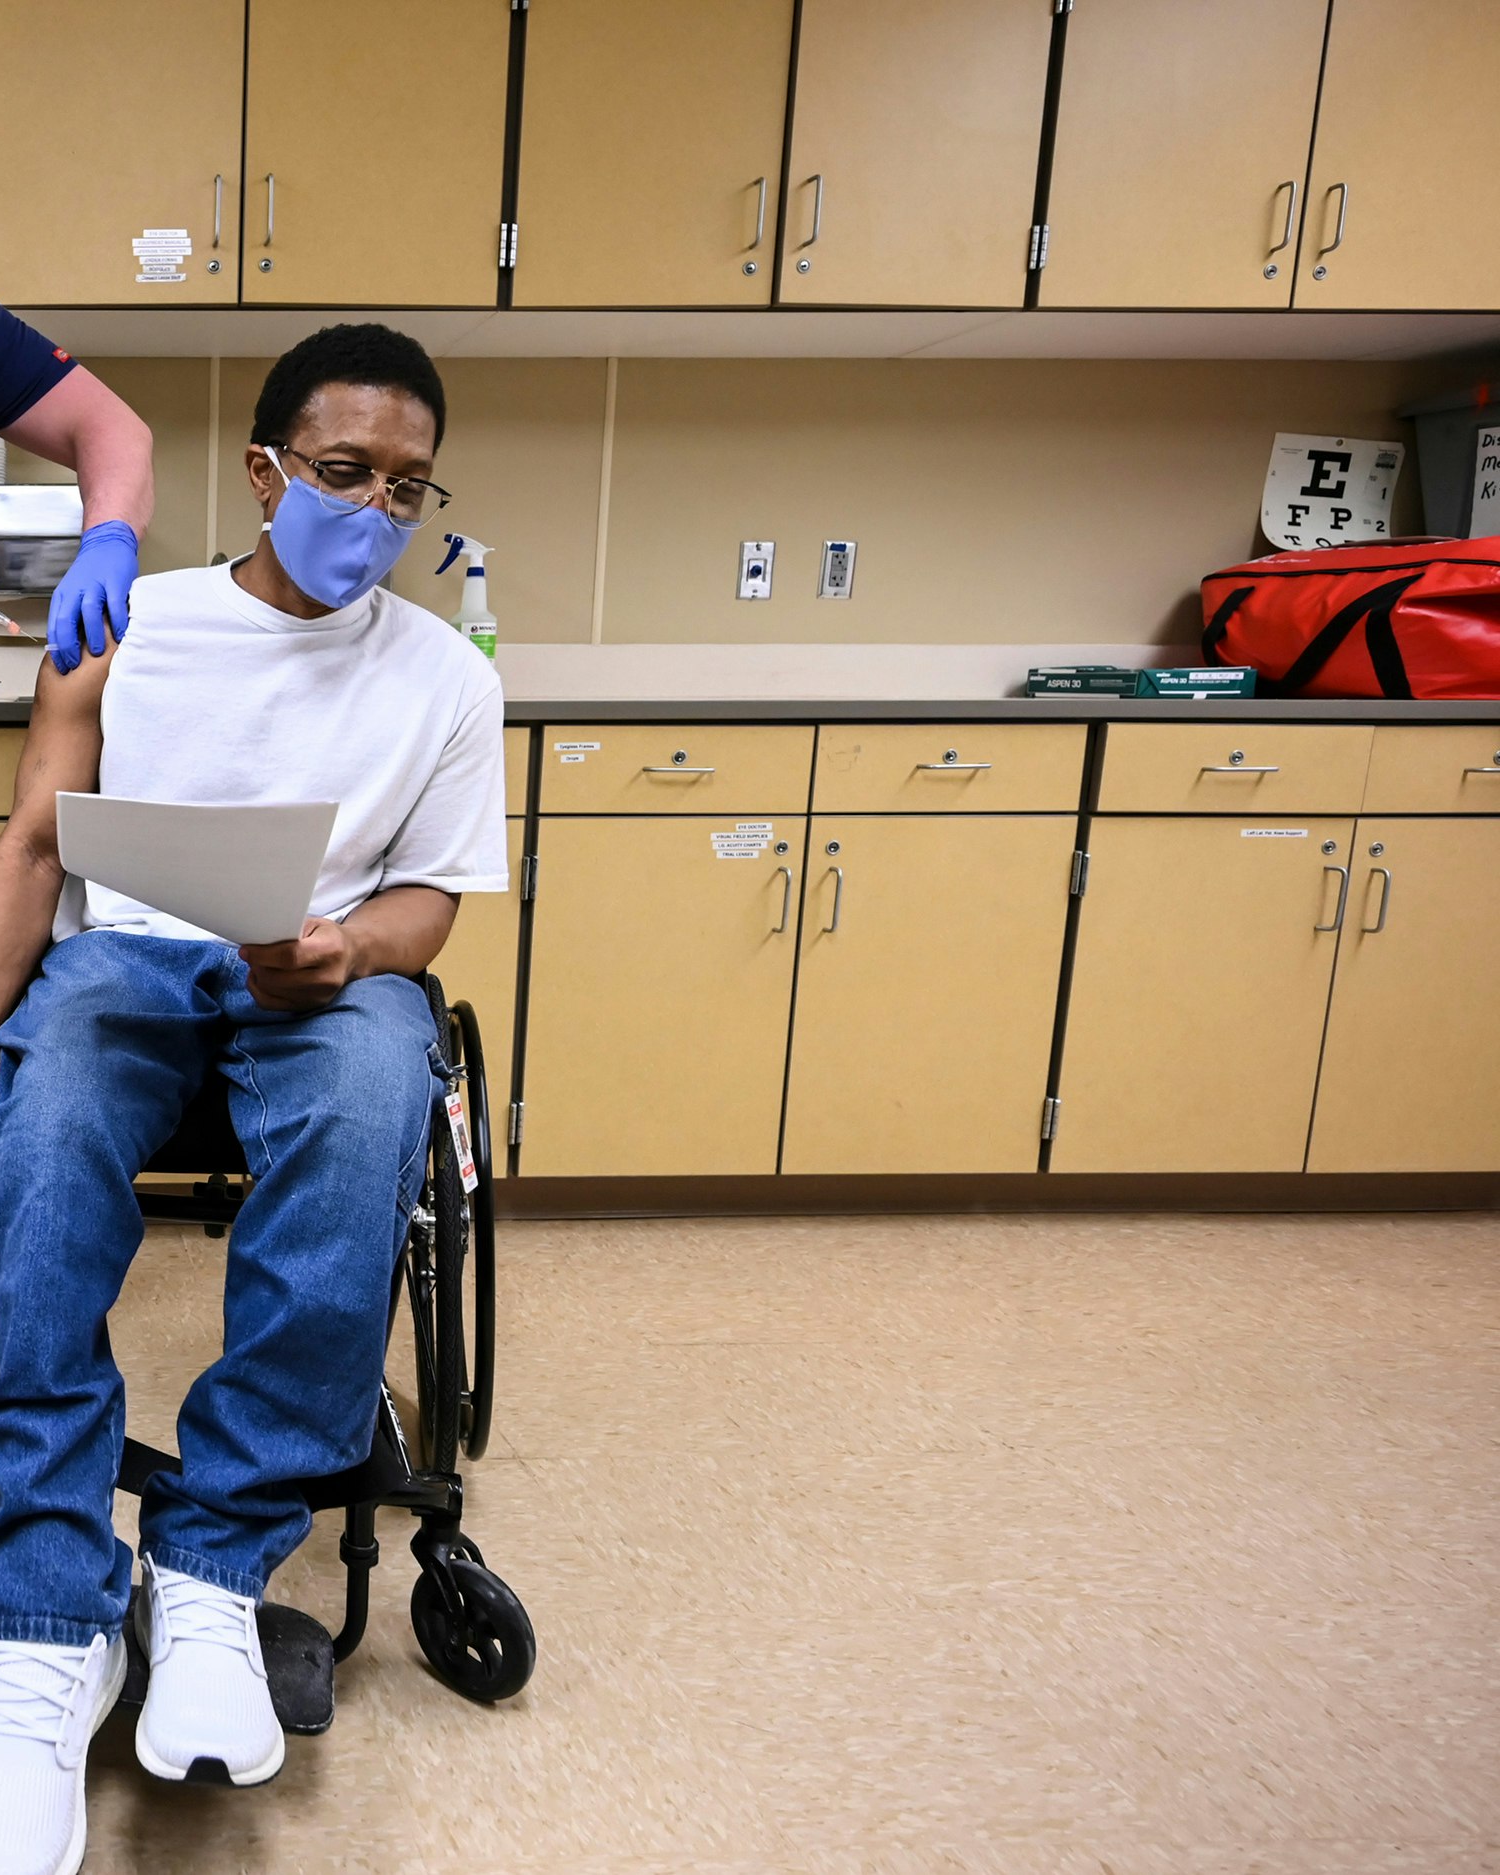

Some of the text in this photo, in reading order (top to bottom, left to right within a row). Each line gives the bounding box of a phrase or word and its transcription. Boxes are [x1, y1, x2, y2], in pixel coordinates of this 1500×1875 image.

[1300, 450, 1352, 499] E
[1381, 487, 1387, 500] 1
[1288, 504, 1352, 530] F P
[1376, 521, 1386, 532] 2
[1284, 535, 1302, 546] T
[1047, 679, 1070, 688] ASPEN
[1071, 679, 1082, 688] 30
